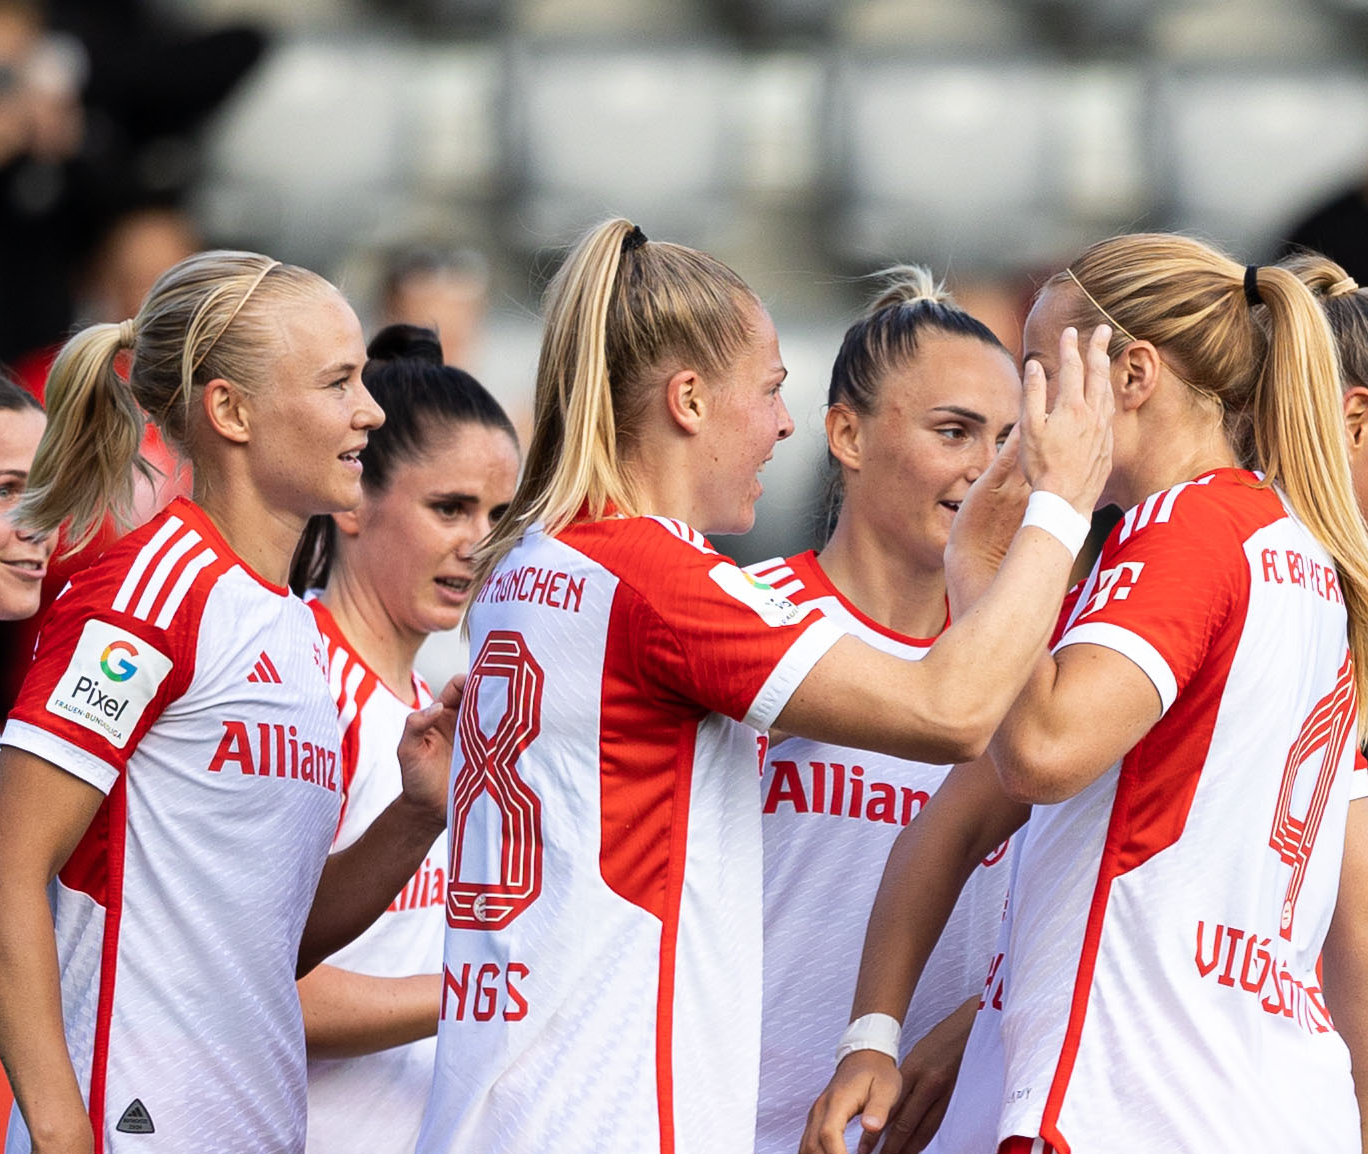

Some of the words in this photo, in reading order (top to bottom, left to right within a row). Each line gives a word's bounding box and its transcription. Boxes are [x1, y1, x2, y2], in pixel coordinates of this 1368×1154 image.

[1286, 550, 1344, 606] BAYER
[71, 675, 130, 722] Pixel
[207, 720, 337, 792] Allianz
